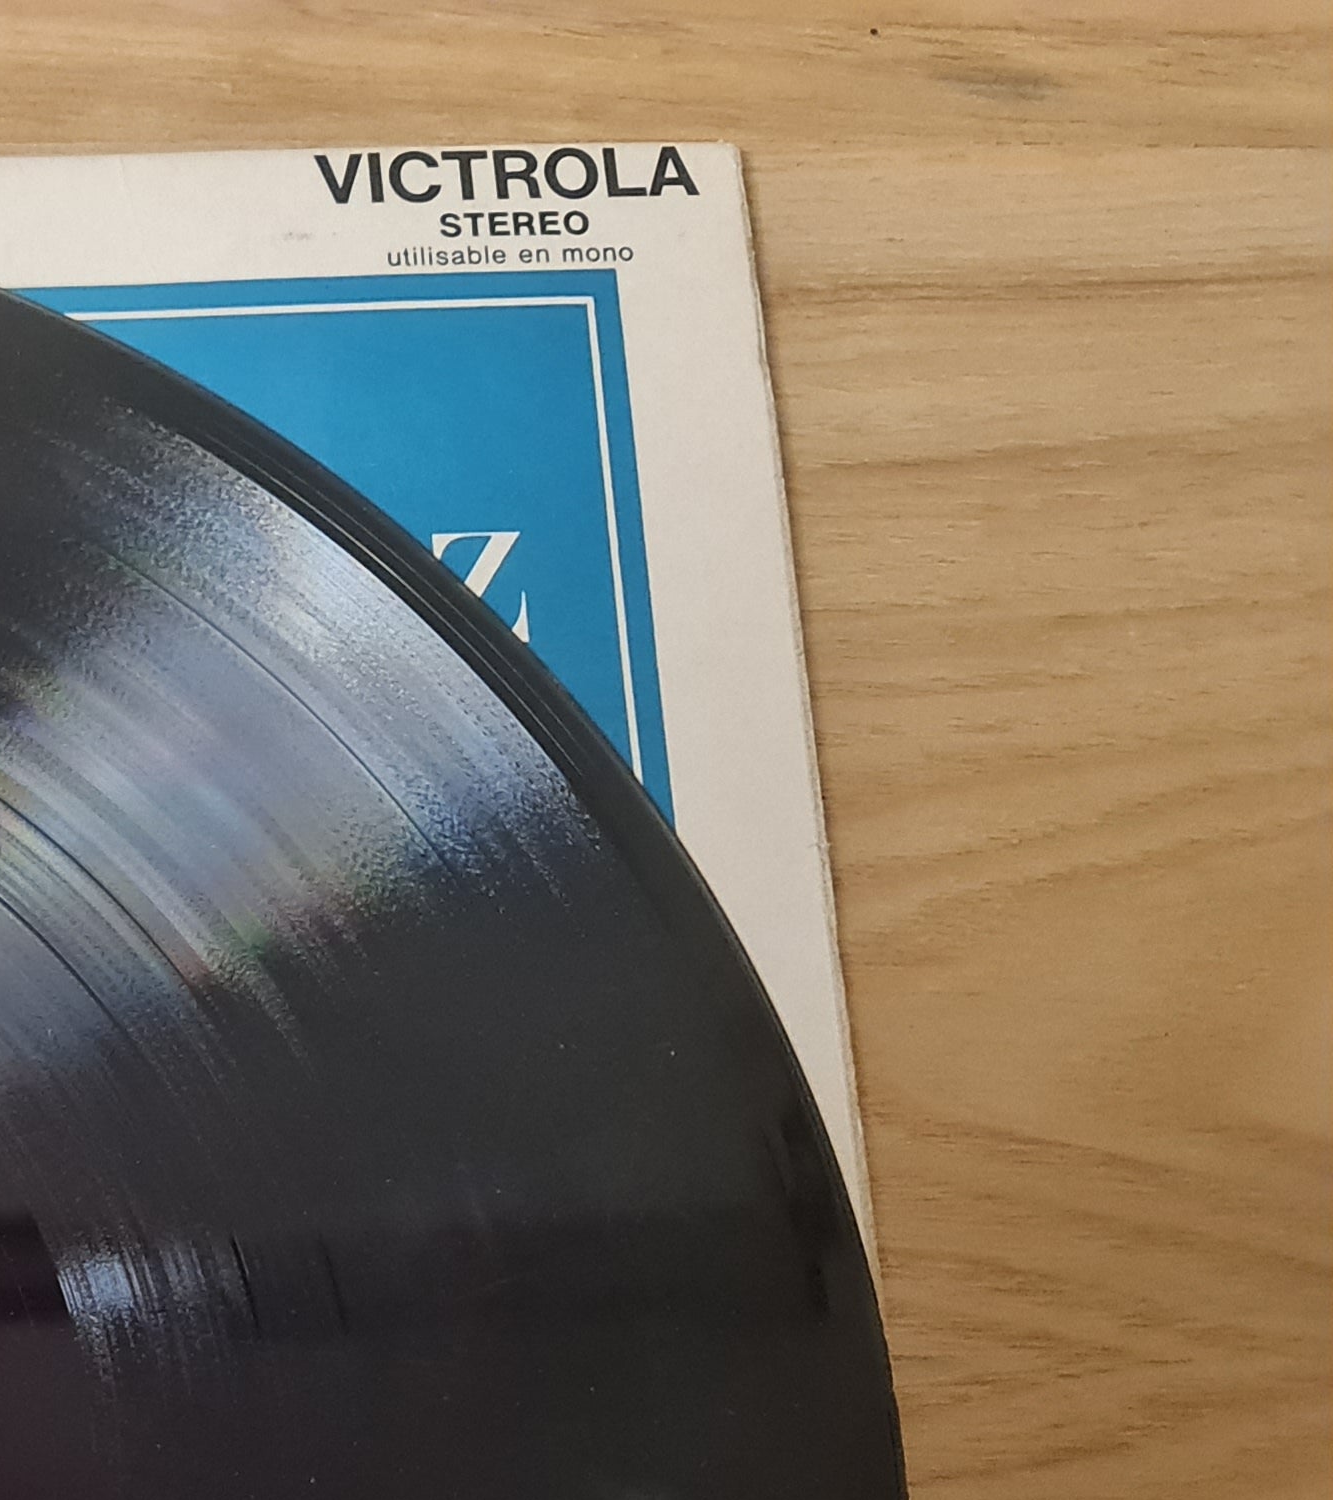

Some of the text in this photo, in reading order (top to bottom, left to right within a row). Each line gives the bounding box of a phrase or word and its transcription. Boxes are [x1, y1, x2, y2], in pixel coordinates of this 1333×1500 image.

[314, 146, 700, 204] VICTROLA
[439, 210, 590, 238] STEREO
[387, 245, 634, 267] utilisable en mono
